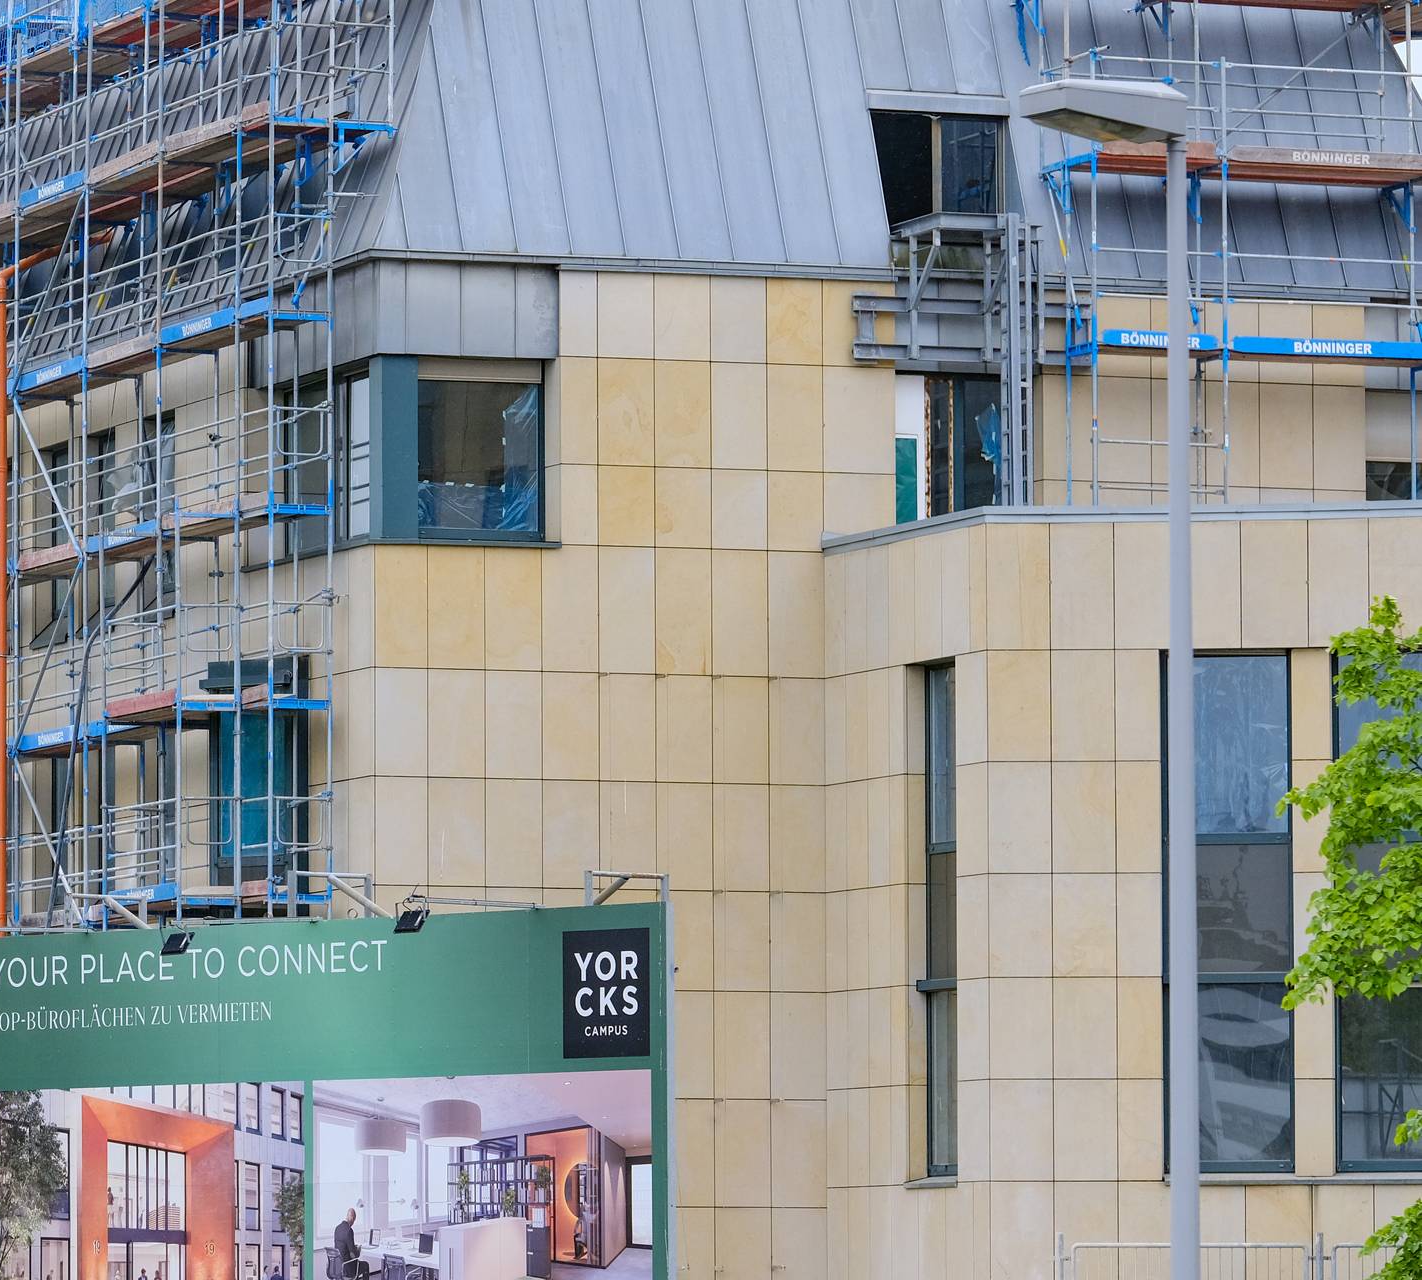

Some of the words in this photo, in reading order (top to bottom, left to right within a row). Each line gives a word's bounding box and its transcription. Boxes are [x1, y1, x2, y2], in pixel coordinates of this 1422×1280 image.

[1292, 150, 1370, 165] BÖNNINGER
[182, 317, 212, 337] BÖNNINGER
[1121, 331, 1200, 349] BÖNNINR
[1293, 339, 1372, 354] BÖNNINGER
[80, 951, 175, 984] PLACE
[185, 947, 225, 979] TO
[237, 940, 388, 977] CONNECT
[573, 950, 639, 982] YOR
[575, 985, 639, 1017] CKS
[150, 1005, 172, 1026] ZU
[177, 1001, 272, 1025] VERMIETEN
[584, 1024, 628, 1037] CAMPUS
[204, 1240, 216, 1256] 19
